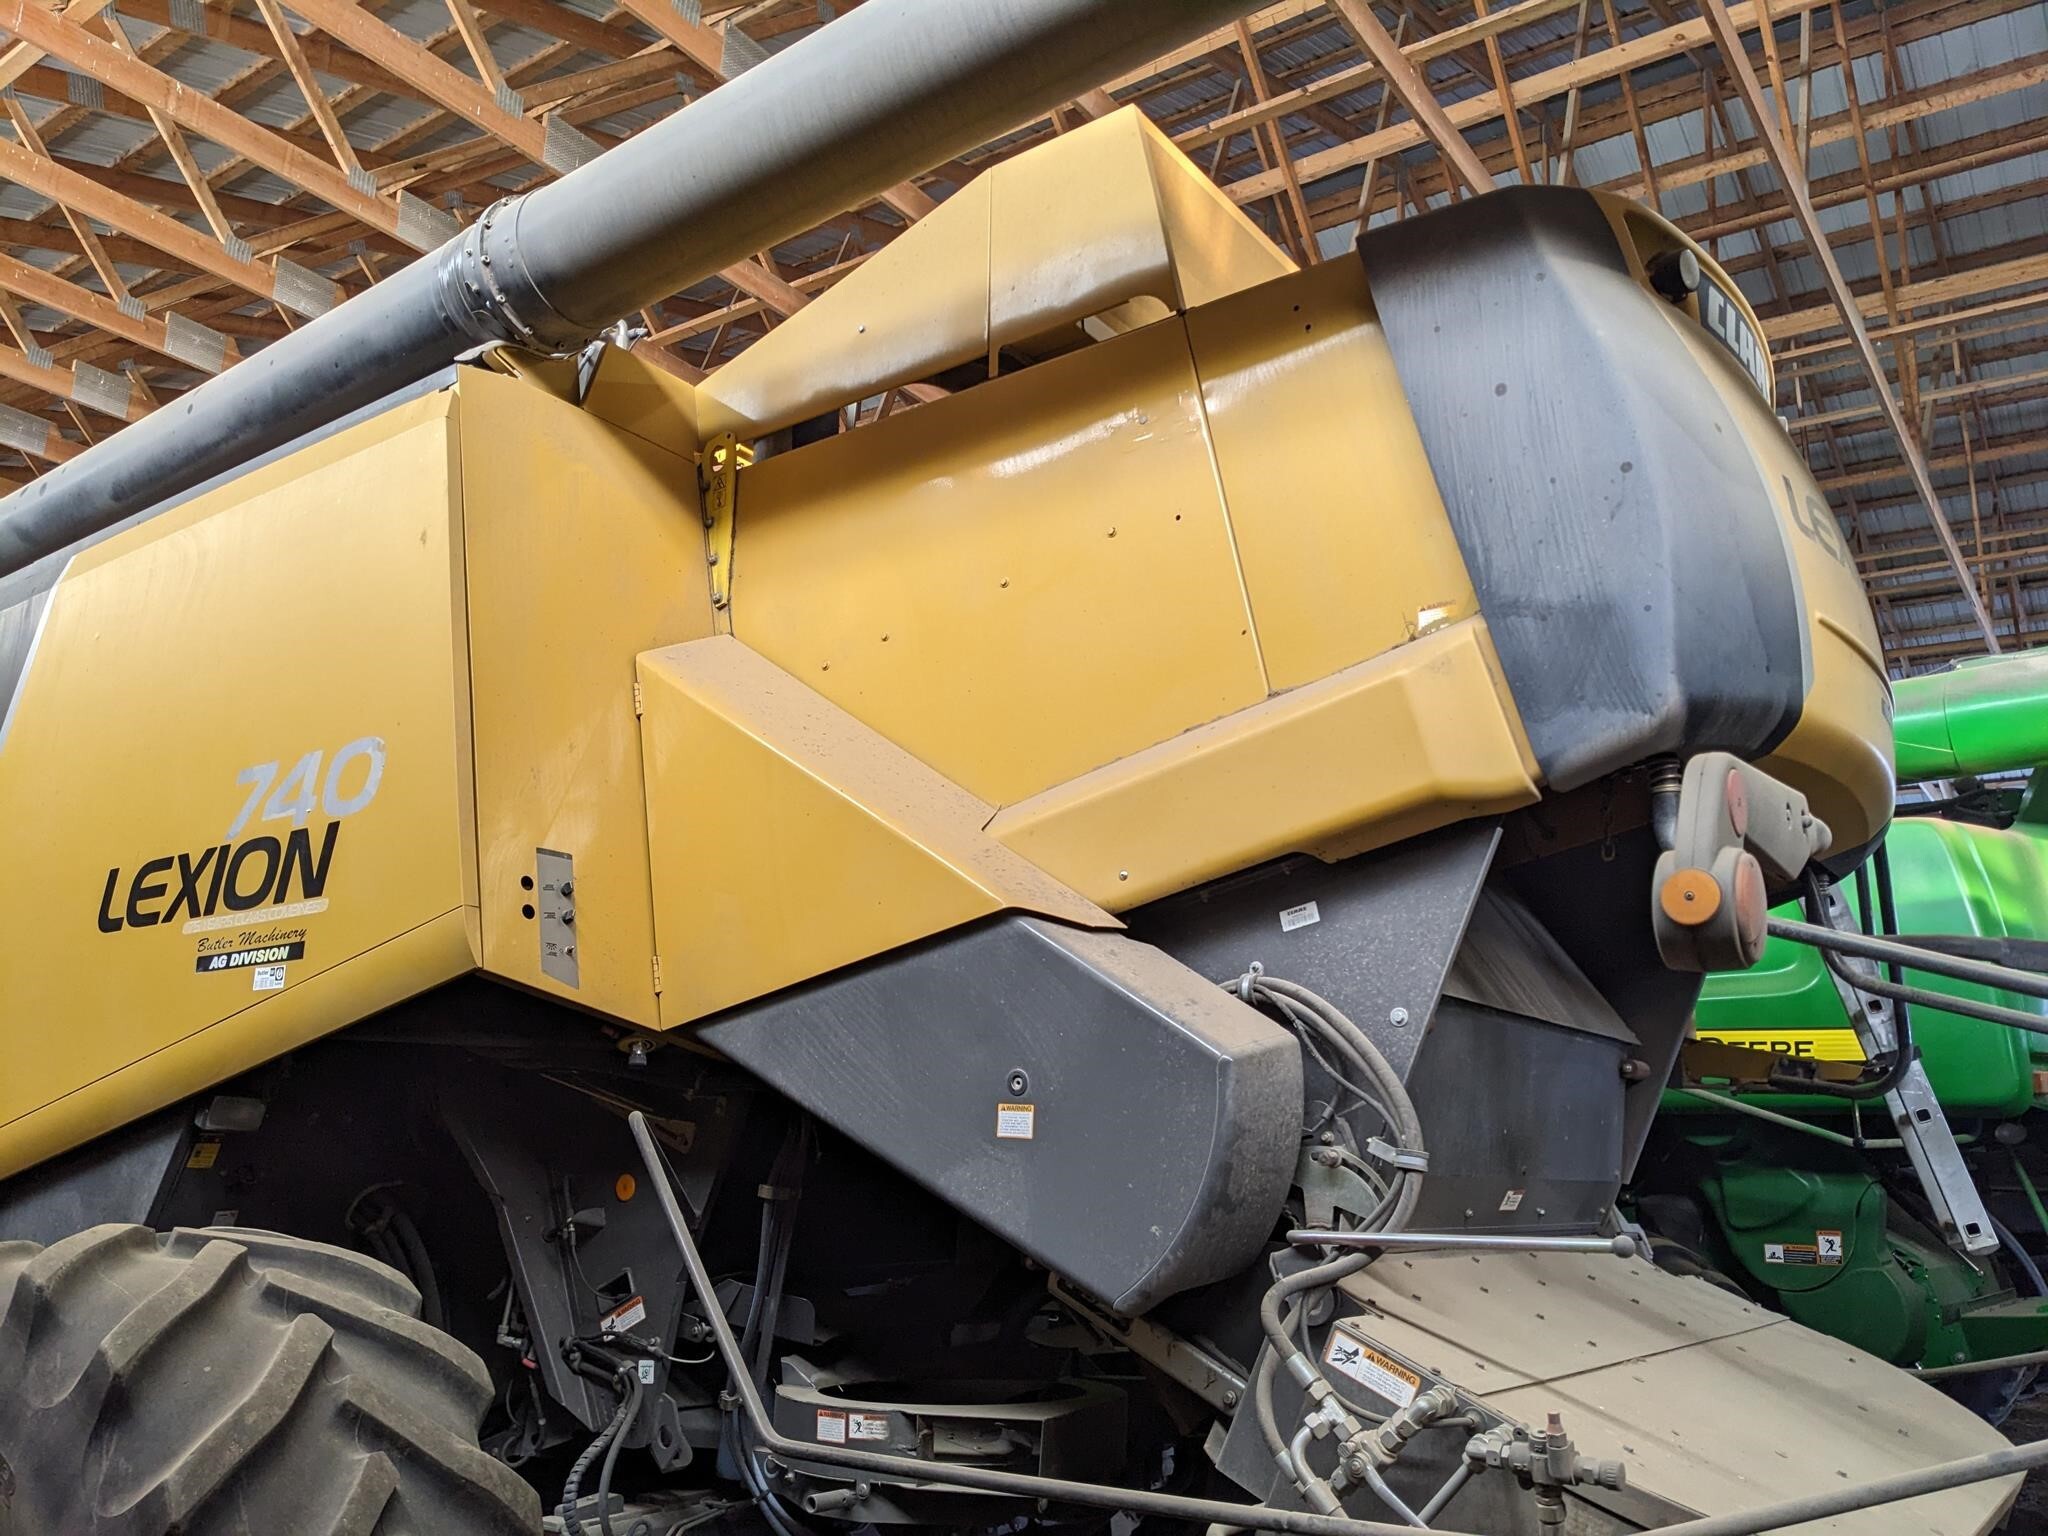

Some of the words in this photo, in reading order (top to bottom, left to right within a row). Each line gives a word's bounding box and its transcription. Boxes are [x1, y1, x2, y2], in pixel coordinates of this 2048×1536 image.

[1707, 285, 1769, 402] CLAA
[225, 735, 386, 841] 740
[97, 820, 341, 934] LEXION
[197, 936, 233, 953] Butler
[238, 926, 308, 946] Machinery
[209, 955, 228, 970] AG
[229, 945, 290, 967] DIVISION
[1700, 1036, 1816, 1059] ERE
[1376, 1357, 1417, 1386] WARNING
